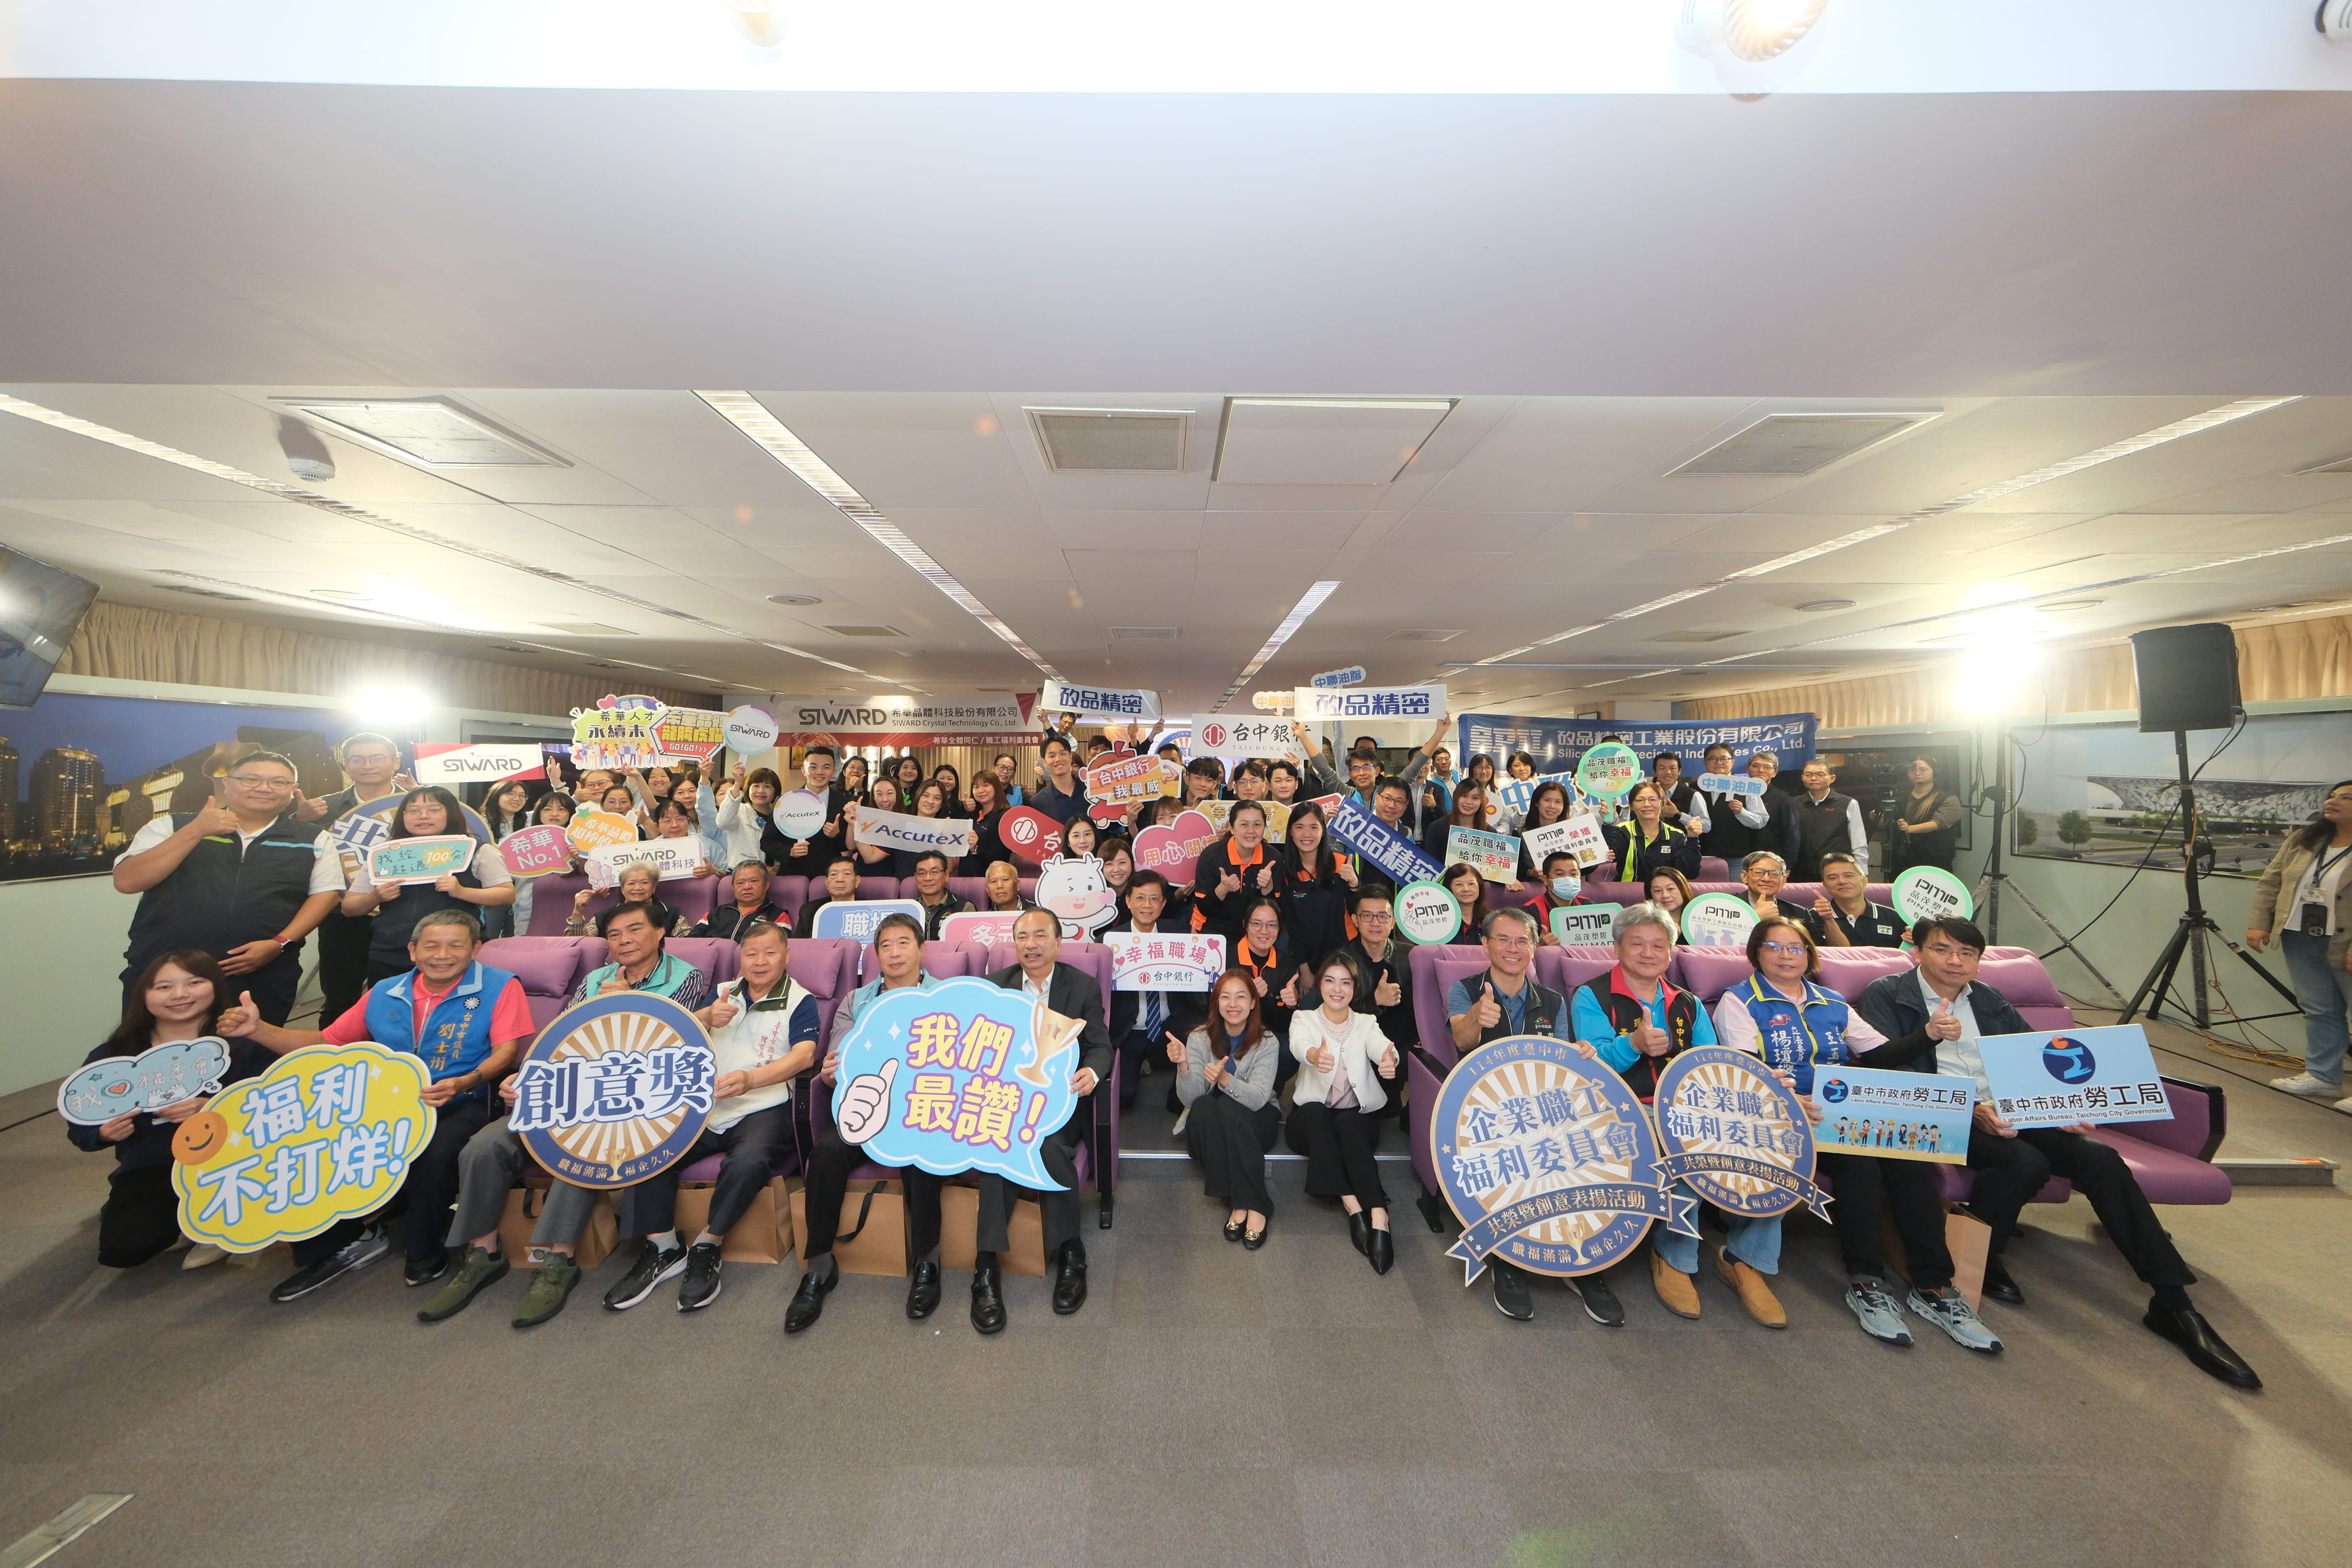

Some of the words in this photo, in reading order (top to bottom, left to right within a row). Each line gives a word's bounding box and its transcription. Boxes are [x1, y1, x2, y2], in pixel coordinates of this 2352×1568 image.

[1315, 669, 1362, 688] 中聯油脂
[1059, 687, 1143, 714] 矽品精密
[1316, 691, 1430, 716] 矽品精密
[600, 711, 655, 722] 希華人才
[799, 709, 887, 725] SIWARD
[892, 707, 1017, 718] 希華晶體科技股份有限公司
[730, 724, 770, 739] SIWARD
[933, 736, 978, 745] 希華全體同仁
[986, 736, 1039, 744] 職工福利委員會
[1781, 737, 1806, 750] Ltd.
[443, 758, 523, 772] SIWARD
[1098, 758, 1150, 786] 台中銀行
[1587, 756, 1627, 767] 品茂職福
[1589, 766, 1632, 780] 給你幸福
[1114, 779, 1160, 799] 我最威
[1701, 777, 1762, 795] 中聯油脂
[510, 829, 554, 854] 希華
[874, 824, 966, 845] AccuteX
[1457, 833, 1507, 852] 品茂職福
[1568, 826, 1592, 840] 榮獲
[613, 849, 676, 866] SIWARD
[1458, 849, 1512, 870] 給你幸福
[1574, 931, 1607, 941] 品茂塑膠
[1125, 941, 1207, 965] 幸福職場
[1154, 971, 1194, 983] 台中銀行
[451, 1012, 472, 1059] 台中市議員
[908, 1014, 1014, 1075] 我們
[1791, 1025, 1806, 1062] 立法委員
[430, 1023, 456, 1071] 劉士州
[1468, 1043, 1567, 1076] 114年度臺中市
[515, 1051, 712, 1128] 創意獎
[1851, 1085, 1967, 1105] 臺中市政府勞工局
[1997, 1082, 2164, 1113] 臺中市政府勞工局
[245, 1062, 366, 1149] 福利
[1466, 1080, 1613, 1145] 企業職工
[1682, 1082, 1790, 1122] 企業職工
[2076, 1111, 2108, 1120] Taichung
[2124, 1107, 2167, 1115] Government
[1667, 1110, 1802, 1156] 福利委員會
[557, 1158, 608, 1179] 職福滿滿
[1457, 1122, 1635, 1195] 福利委員會
[1682, 1156, 1800, 1192] 共榮暨創意表揚活動
[1696, 1176, 1738, 1205] 職福滿滿
[1486, 1187, 1646, 1240] 共榮暨創意表揚活動
[1512, 1241, 1572, 1263] 職福滿滿
